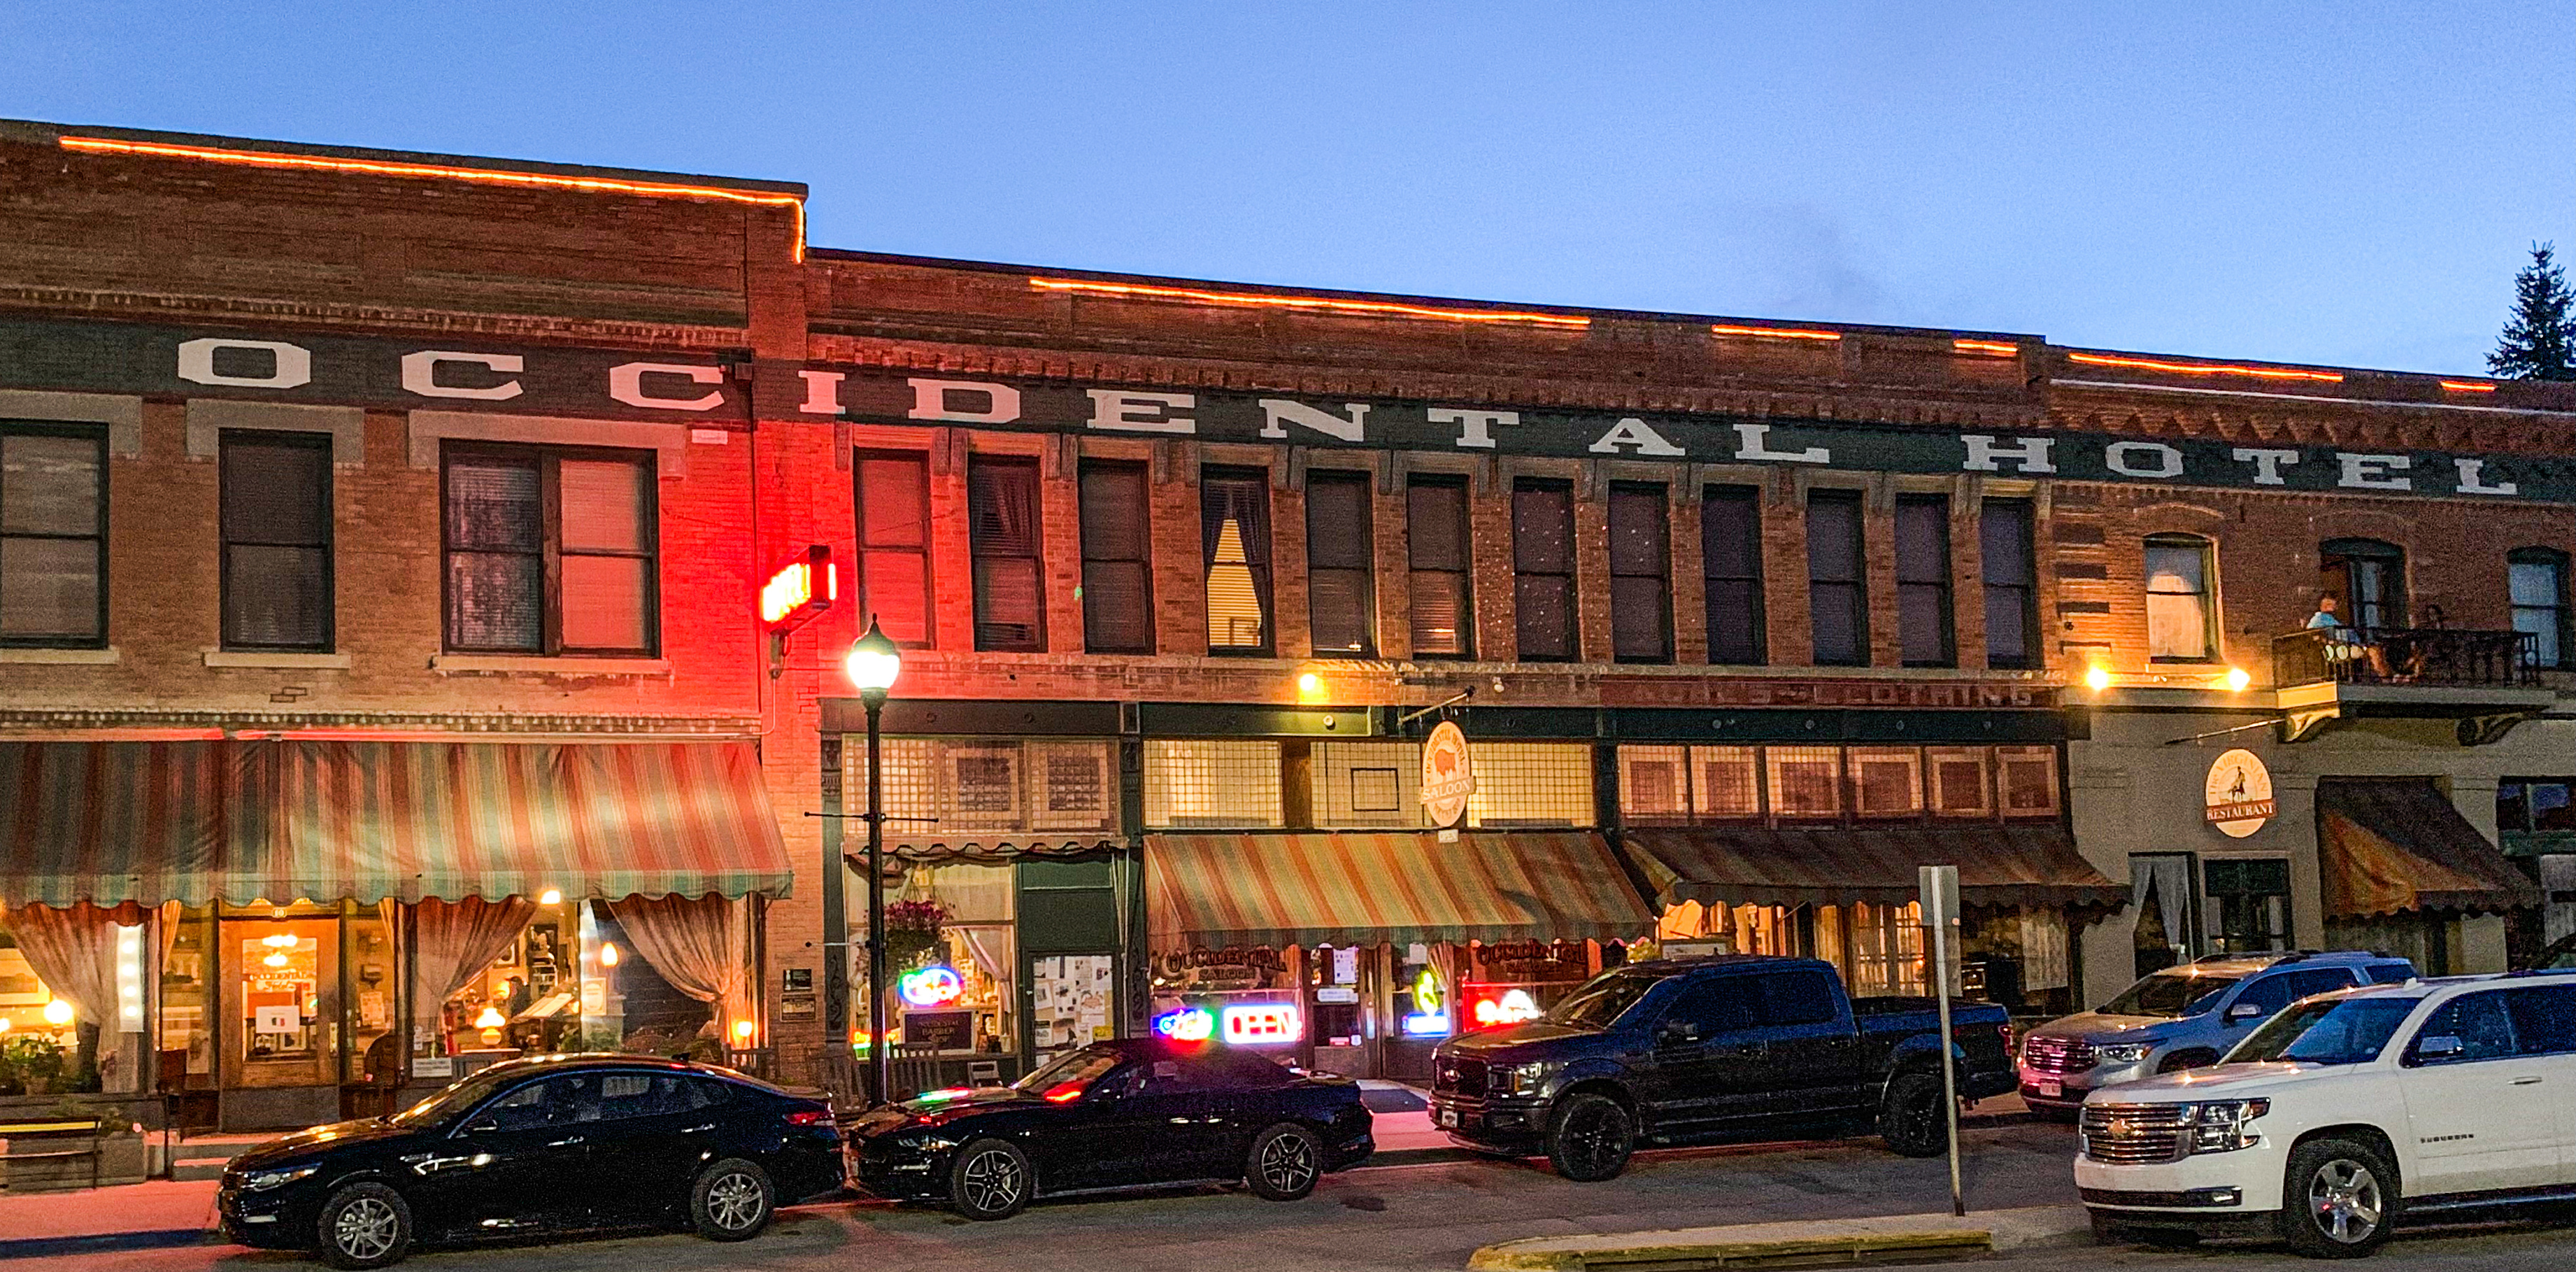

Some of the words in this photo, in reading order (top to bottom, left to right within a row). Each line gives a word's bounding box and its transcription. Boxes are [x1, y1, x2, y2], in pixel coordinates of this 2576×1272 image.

[178, 337, 1830, 463] OCCIDENTAL
[1960, 434, 2517, 496] HOTEL
[2216, 754, 2268, 792] VIRGINIAN
[1423, 781, 1470, 800] SALOON
[2207, 803, 2274, 820] RESTAURANT
[1166, 947, 1288, 973] OCCIDENTAL
[1476, 942, 1588, 966] OCCIDENTAL
[1198, 968, 1256, 980] SALOON
[1229, 1012, 1293, 1037] OPEN
